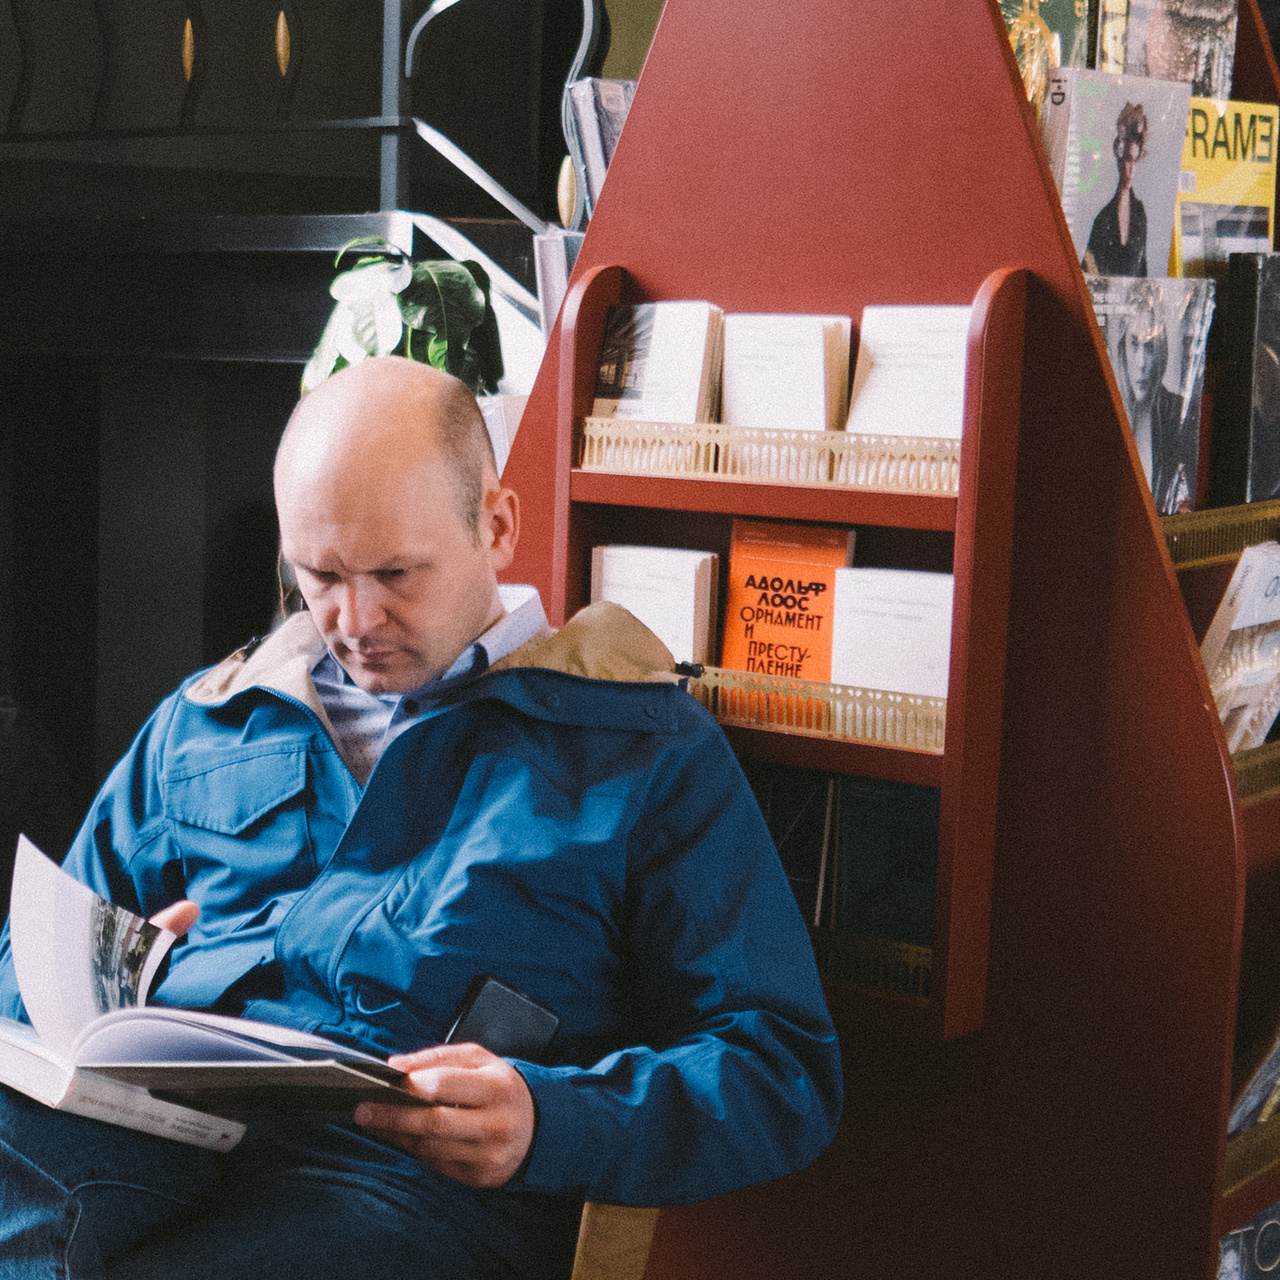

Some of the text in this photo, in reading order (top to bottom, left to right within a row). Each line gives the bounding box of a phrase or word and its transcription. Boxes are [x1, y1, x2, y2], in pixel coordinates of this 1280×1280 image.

[1051, 78, 1067, 106] i-D
[744, 574, 827, 597] АДОЛЬФ
[757, 592, 810, 612] ЛООС
[739, 605, 825, 631] ОРНАМЕНТ
[744, 623, 754, 639] И
[748, 640, 812, 663] ПРЕСТУ-
[746, 657, 803, 680] ПЛЕНИЕ
